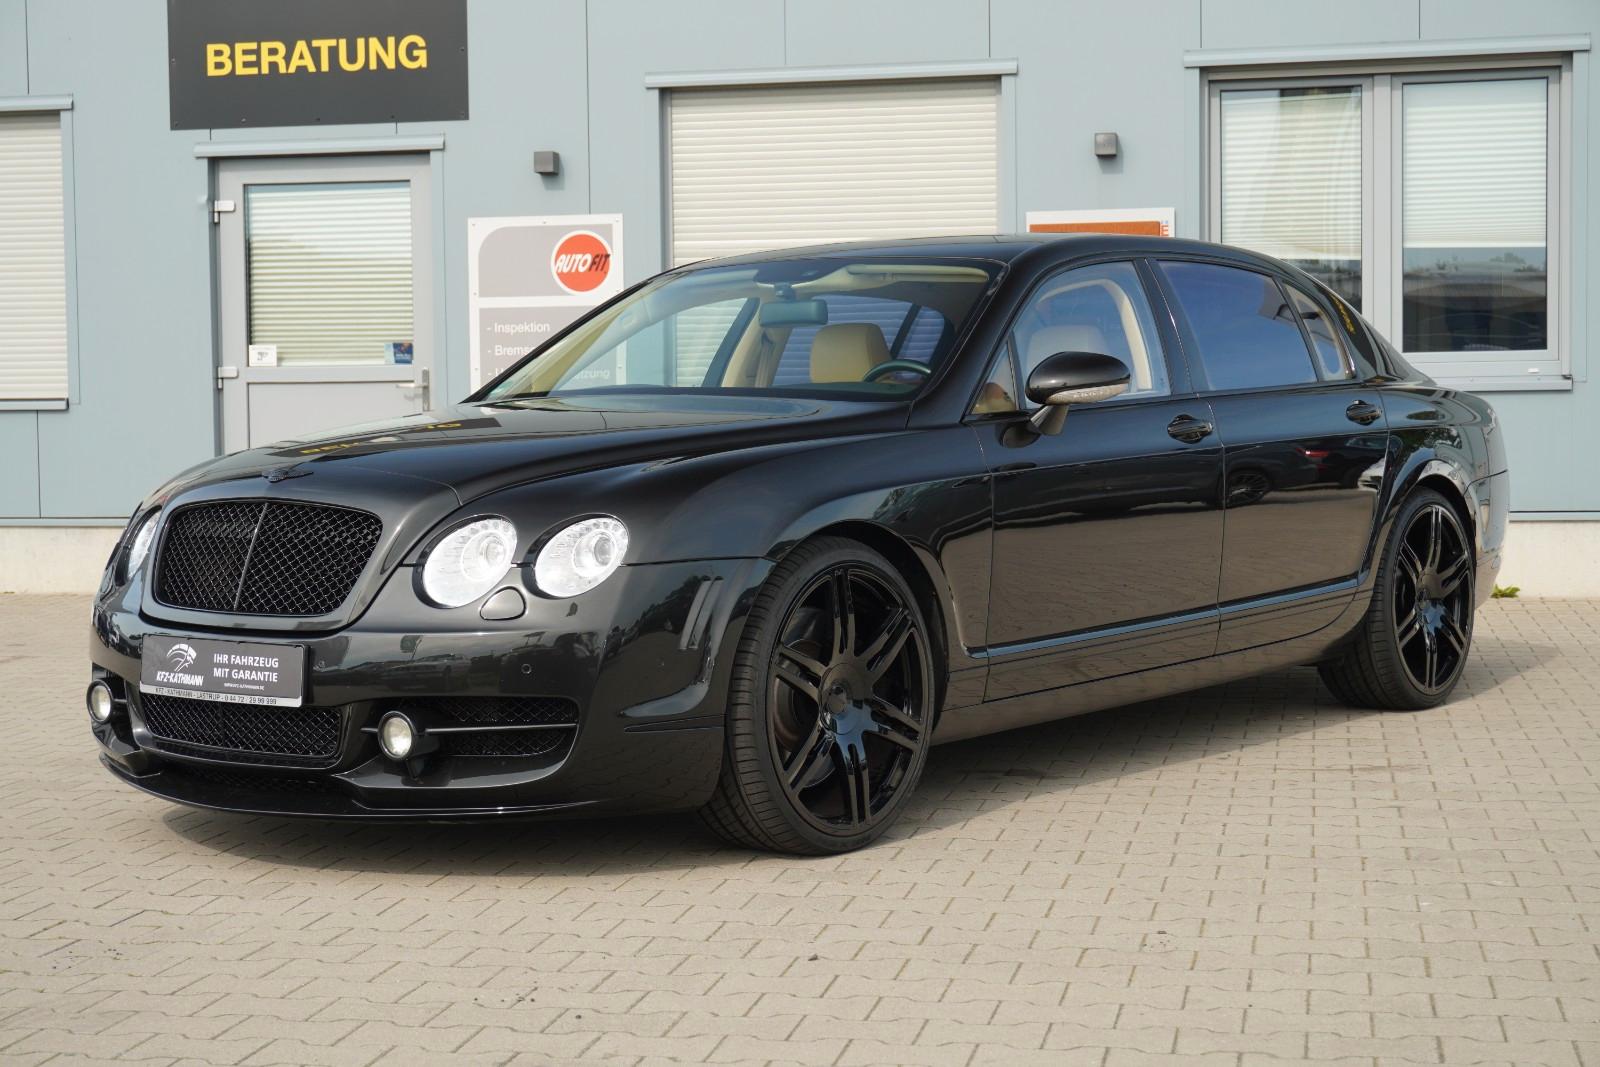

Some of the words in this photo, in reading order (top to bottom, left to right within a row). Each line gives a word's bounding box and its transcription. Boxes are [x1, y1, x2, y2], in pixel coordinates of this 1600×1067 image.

[206, 34, 428, 77] BERATUNG
[494, 321, 550, 334] Inspektion
[213, 653, 229, 665] IHR
[231, 654, 279, 669] FAHRZEUG
[156, 670, 204, 687] KFZ-KATHMANN
[213, 667, 230, 679] MIT
[231, 669, 278, 683] GARANTIE
[155, 687, 165, 695] KFZ
[196, 691, 221, 700] LASTRUP
